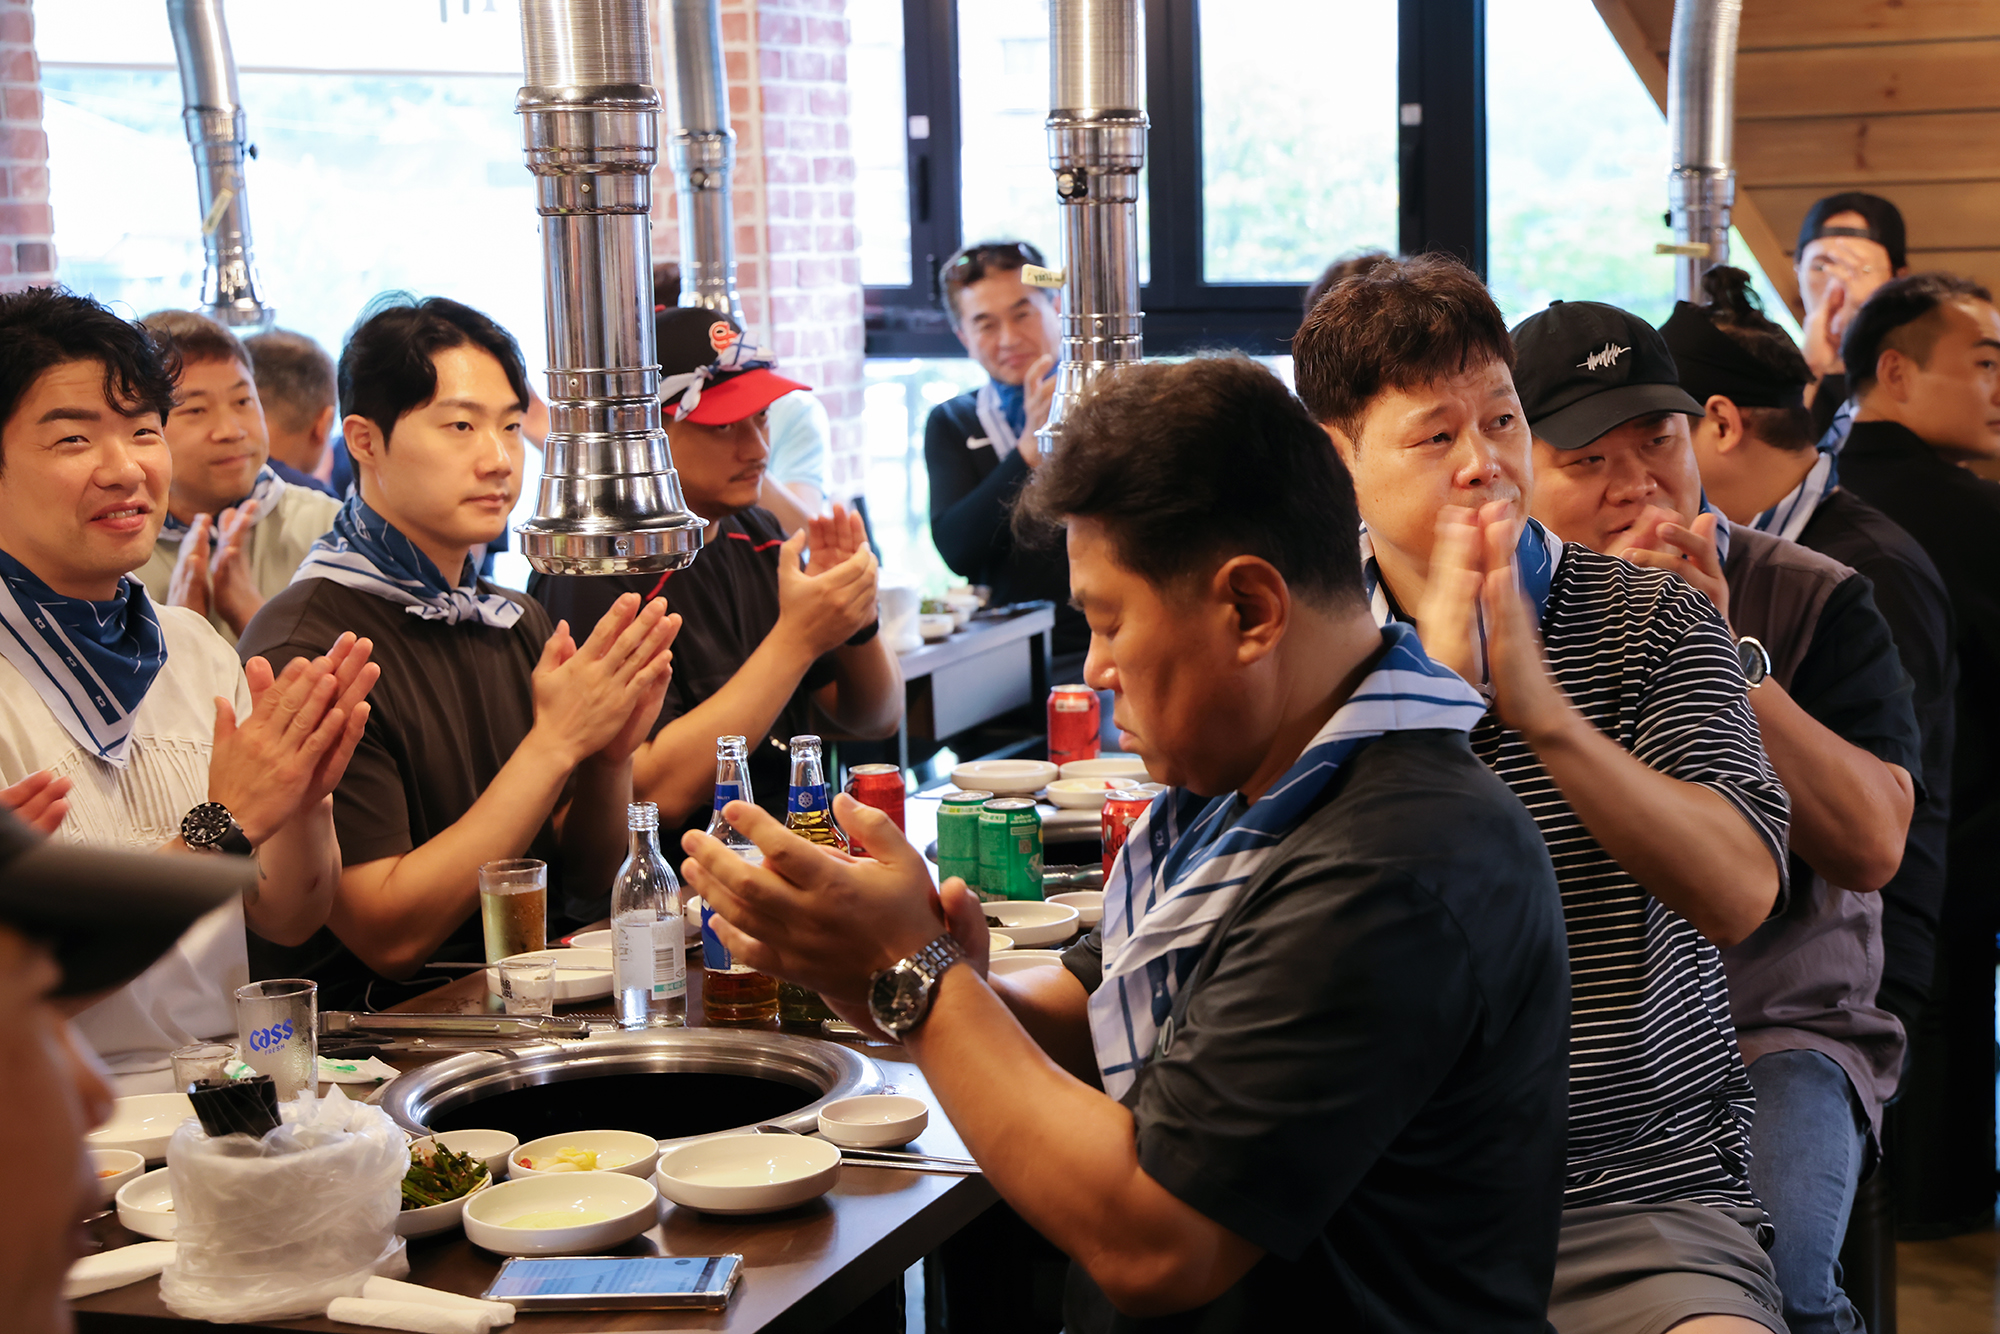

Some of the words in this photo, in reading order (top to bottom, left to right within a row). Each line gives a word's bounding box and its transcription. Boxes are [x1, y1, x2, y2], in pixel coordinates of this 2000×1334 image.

[34, 617, 46, 629] K2
[66, 656, 78, 668] K2
[95, 695, 107, 708] K2
[1116, 806, 1136, 814] ZERO
[264, 1043, 286, 1056] FRESH
